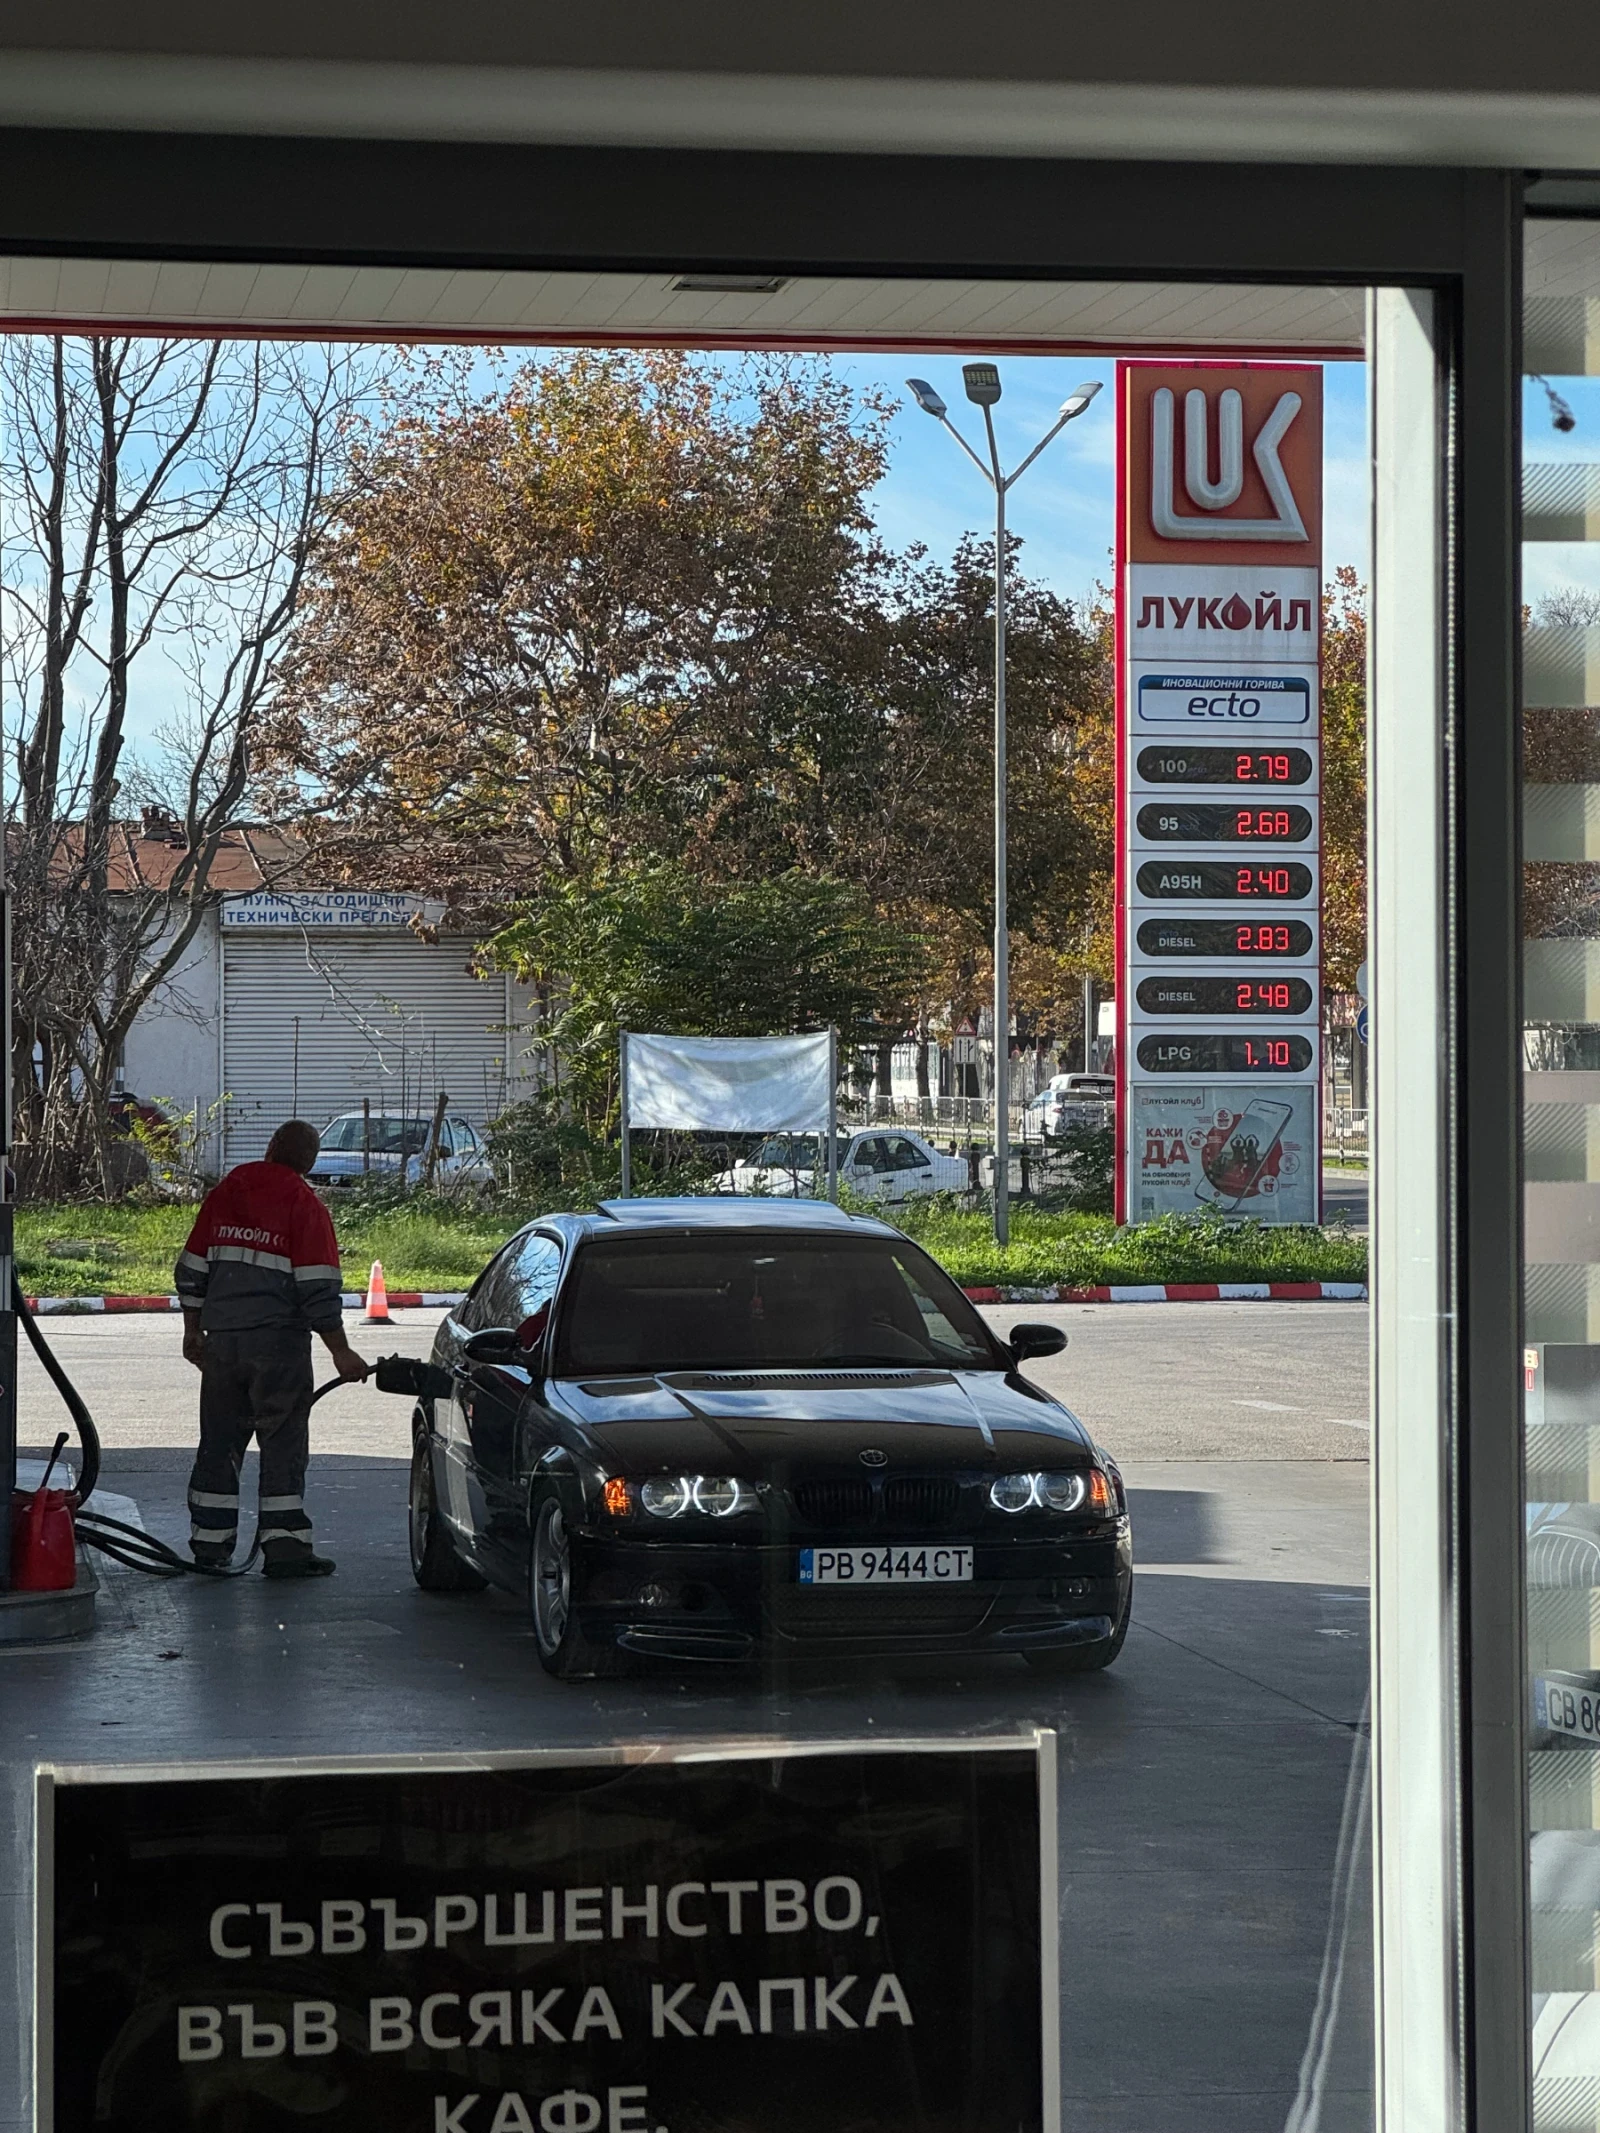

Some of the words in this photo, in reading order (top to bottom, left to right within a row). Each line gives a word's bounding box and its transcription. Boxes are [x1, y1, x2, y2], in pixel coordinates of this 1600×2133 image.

[1162, 678, 1243, 689] ИНОВАЦИОННИ
[1245, 680, 1285, 690] ГОРИВА
[1188, 692, 1260, 718] ecto
[1159, 760, 1187, 773] 100
[1237, 755, 1289, 779] 2.79
[1159, 817, 1179, 831] 95
[1159, 875, 1202, 889] A95H
[1237, 870, 1289, 893] 2.40
[244, 895, 293, 906] ПУНКТ
[300, 895, 319, 906] ЗА
[326, 895, 405, 907] ГОДИШНИ
[227, 911, 332, 922] ТЕХНИЧЕСКИ
[1159, 938, 1196, 947] DIESEL
[1237, 927, 1289, 950] 2.83
[1158, 992, 1196, 1001] DIESEL
[1237, 985, 1289, 1008] 2.48
[1158, 1046, 1191, 1060] LPG
[1245, 1042, 1289, 1065] 1.10
[1146, 1128, 1183, 1137] КАЖИ
[1142, 1140, 1190, 1168] ДА
[218, 1226, 270, 1244] ЛУКОЙЛ
[800, 1570, 812, 1579] BG
[211, 1877, 878, 1957] СЪВЪРШЕНСТВО,
[179, 2002, 337, 2060] ВЪВ
[371, 1987, 621, 2051] ВСЯКА
[653, 1974, 912, 2036] КАПКА
[436, 2087, 667, 2133] КАФЕ.
